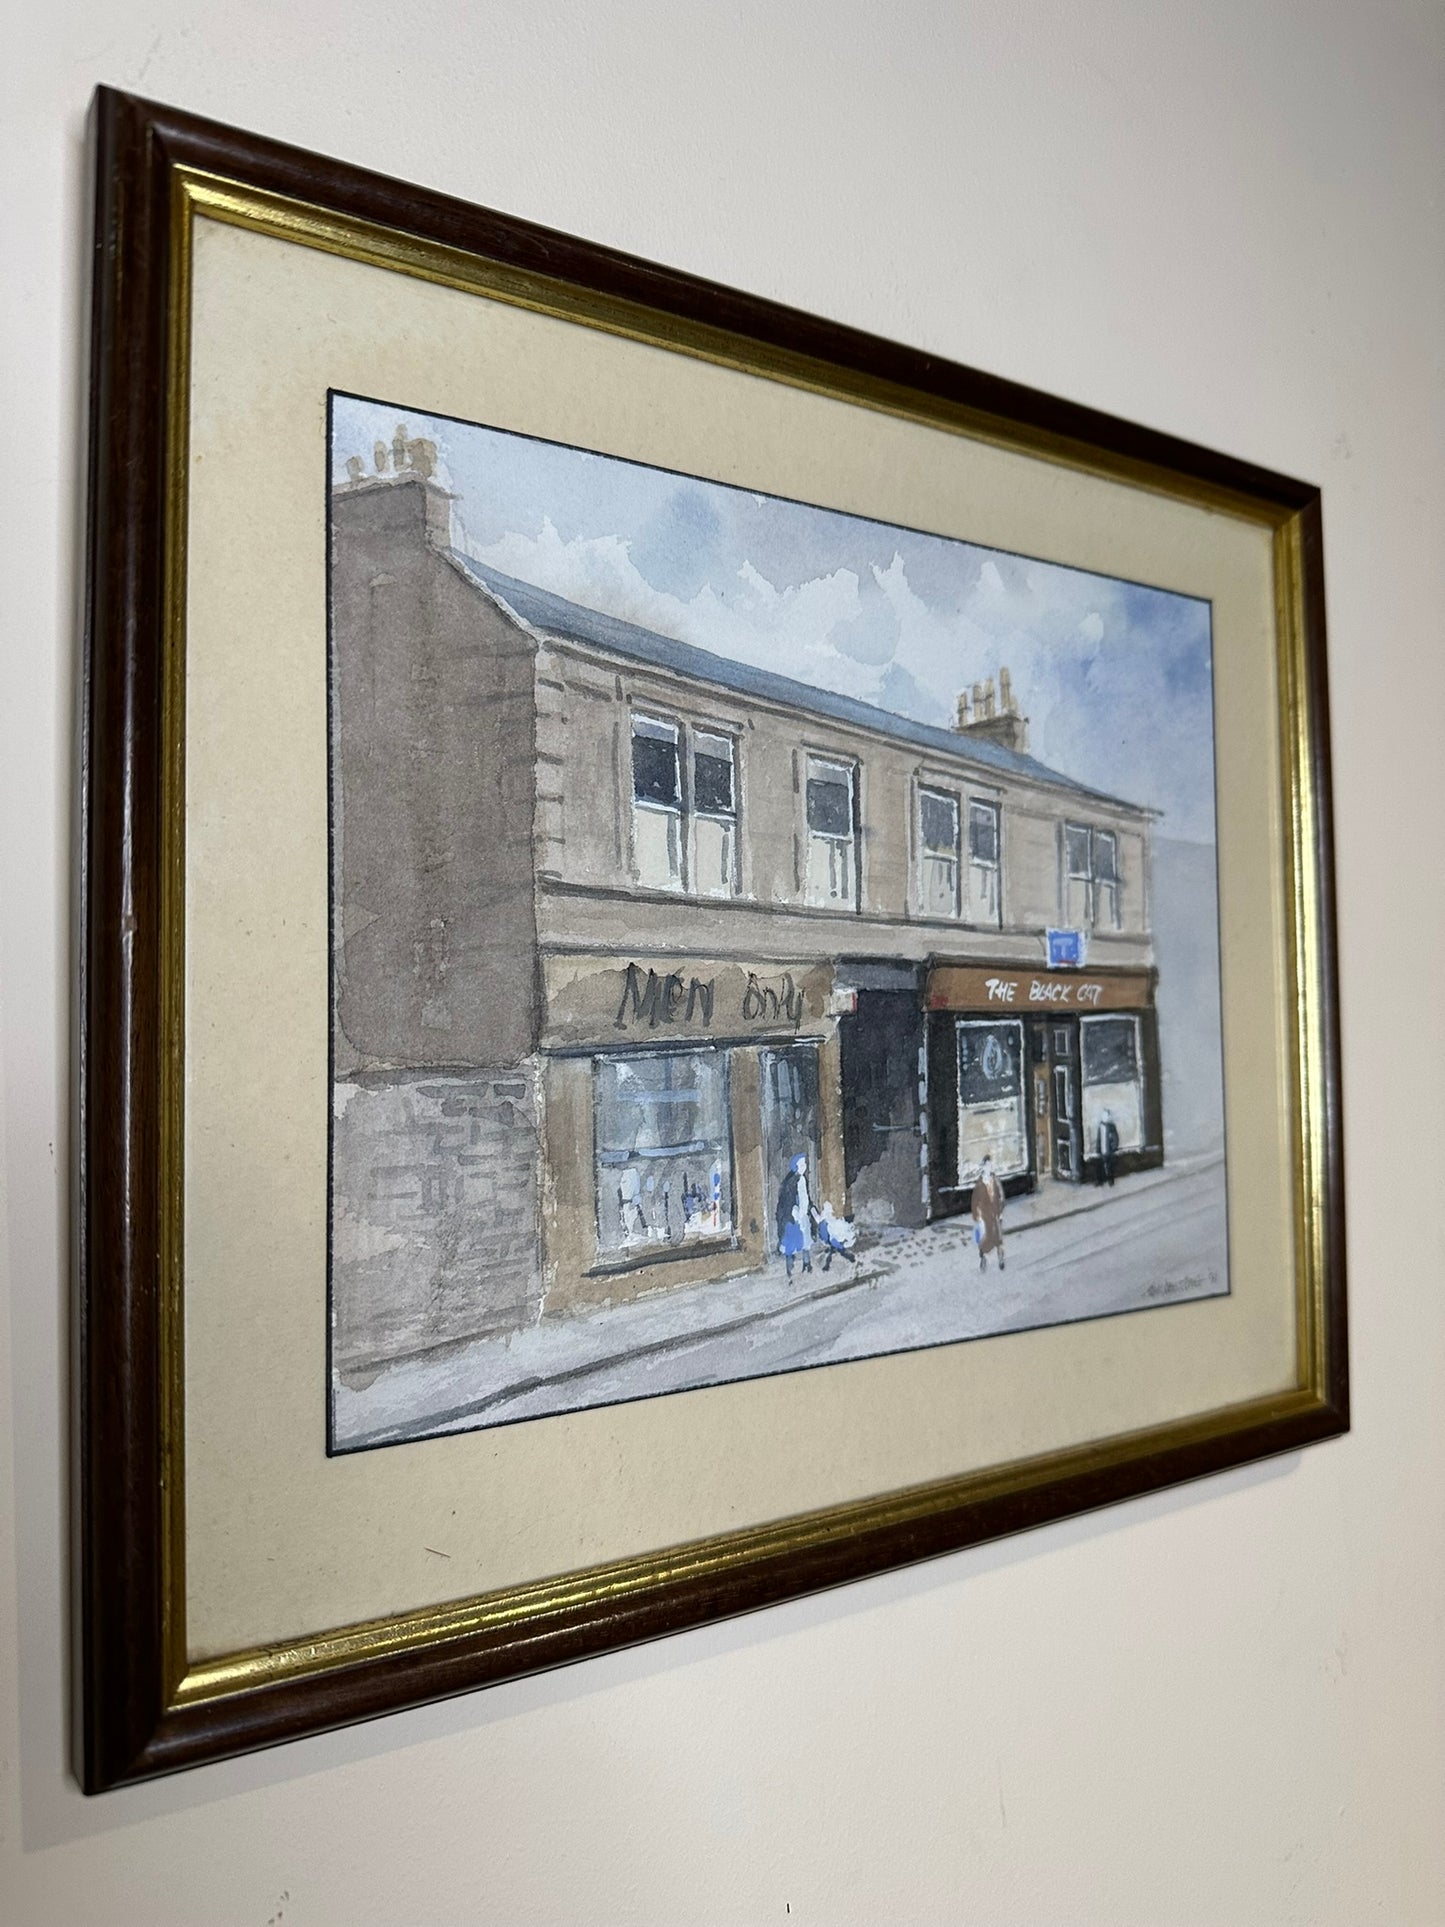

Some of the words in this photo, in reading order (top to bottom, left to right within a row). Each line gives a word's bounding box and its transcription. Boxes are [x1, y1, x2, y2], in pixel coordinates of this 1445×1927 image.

[985, 978, 1018, 1003] THE
[1029, 980, 1072, 1003] BLACK
[1077, 983, 1103, 1006] CAT
